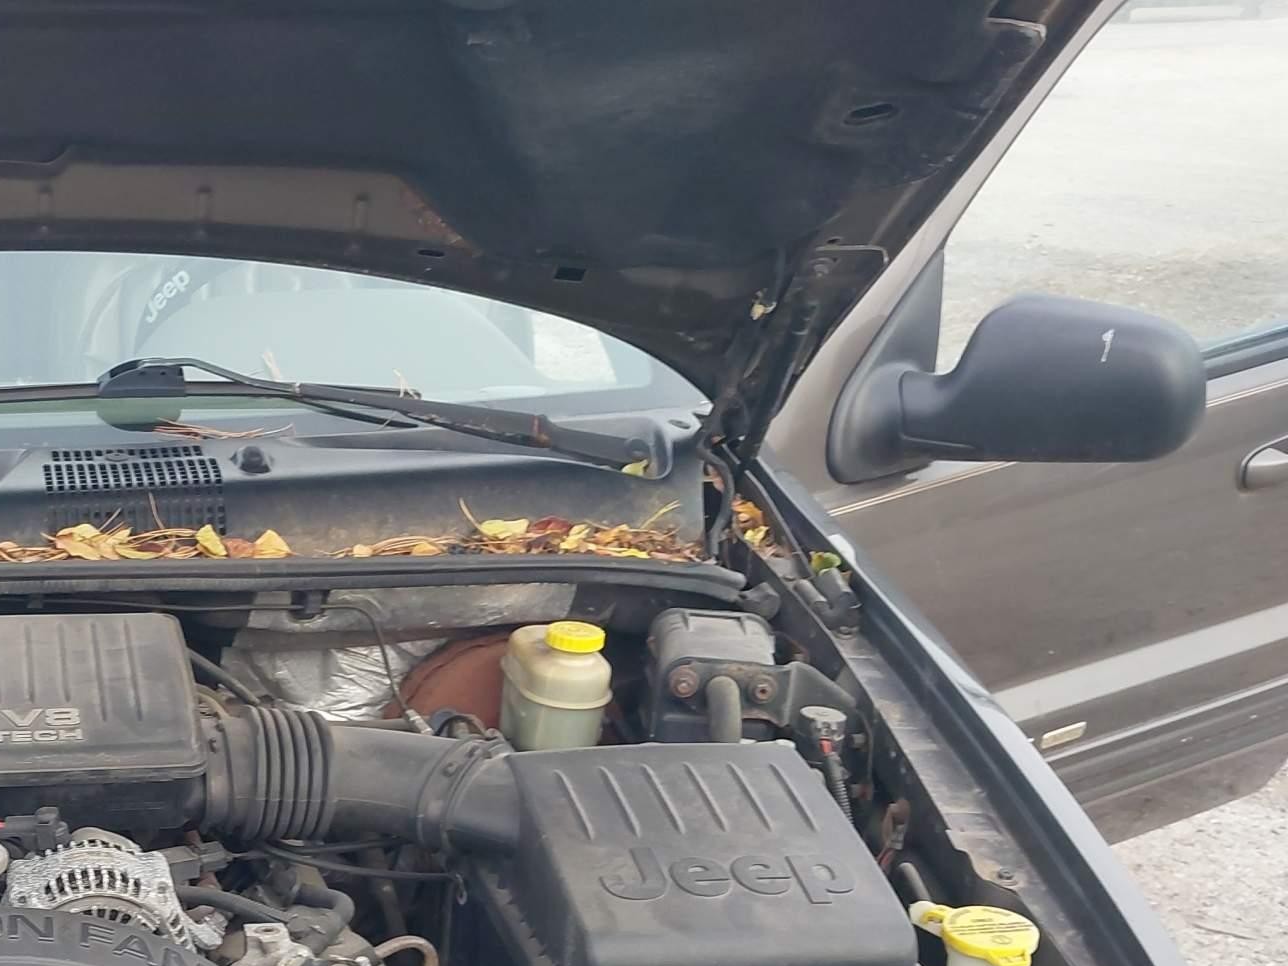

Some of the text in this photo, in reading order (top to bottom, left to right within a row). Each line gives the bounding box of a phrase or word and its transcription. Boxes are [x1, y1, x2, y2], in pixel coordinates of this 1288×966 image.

[145, 270, 191, 323] Jeep
[0, 707, 81, 728] V8
[598, 847, 858, 905] Jeep
